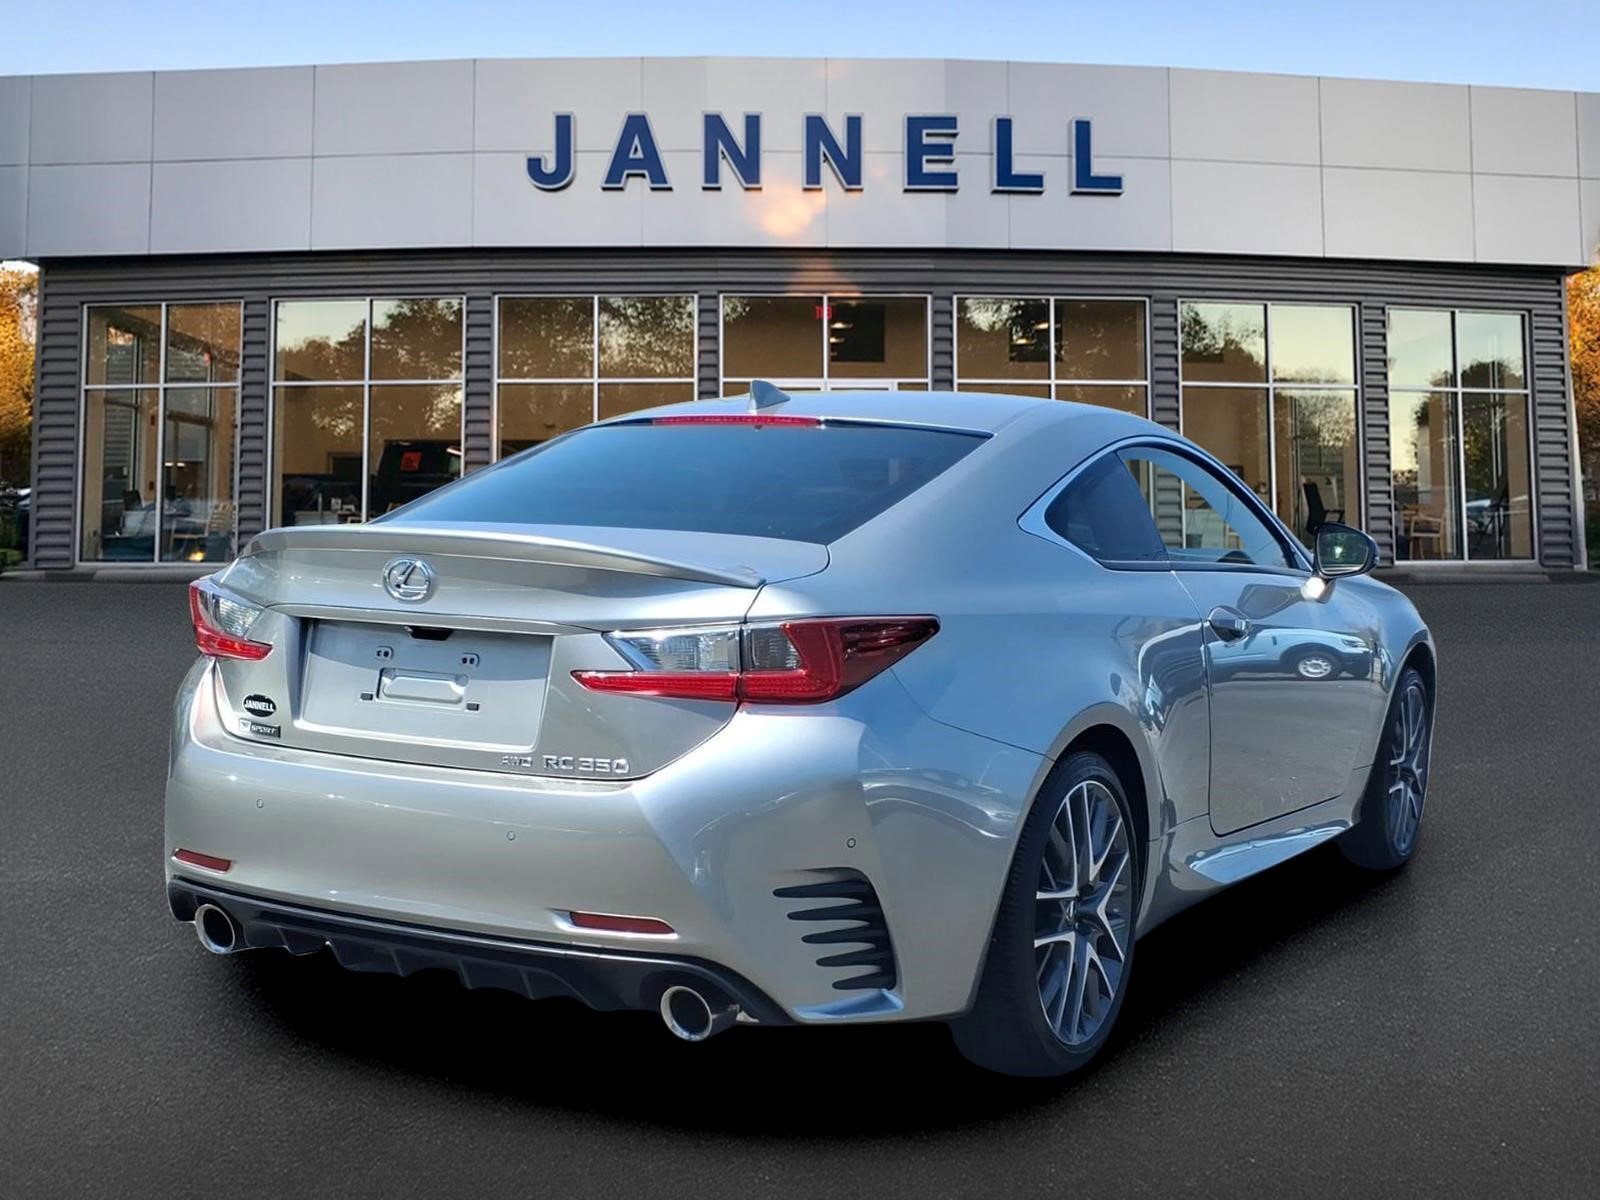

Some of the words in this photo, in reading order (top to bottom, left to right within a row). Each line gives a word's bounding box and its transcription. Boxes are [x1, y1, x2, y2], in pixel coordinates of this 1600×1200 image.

[526, 111, 1124, 196] JANNELL
[244, 699, 275, 712] JANNELL
[542, 754, 574, 770] RC
[578, 757, 630, 774] 350
